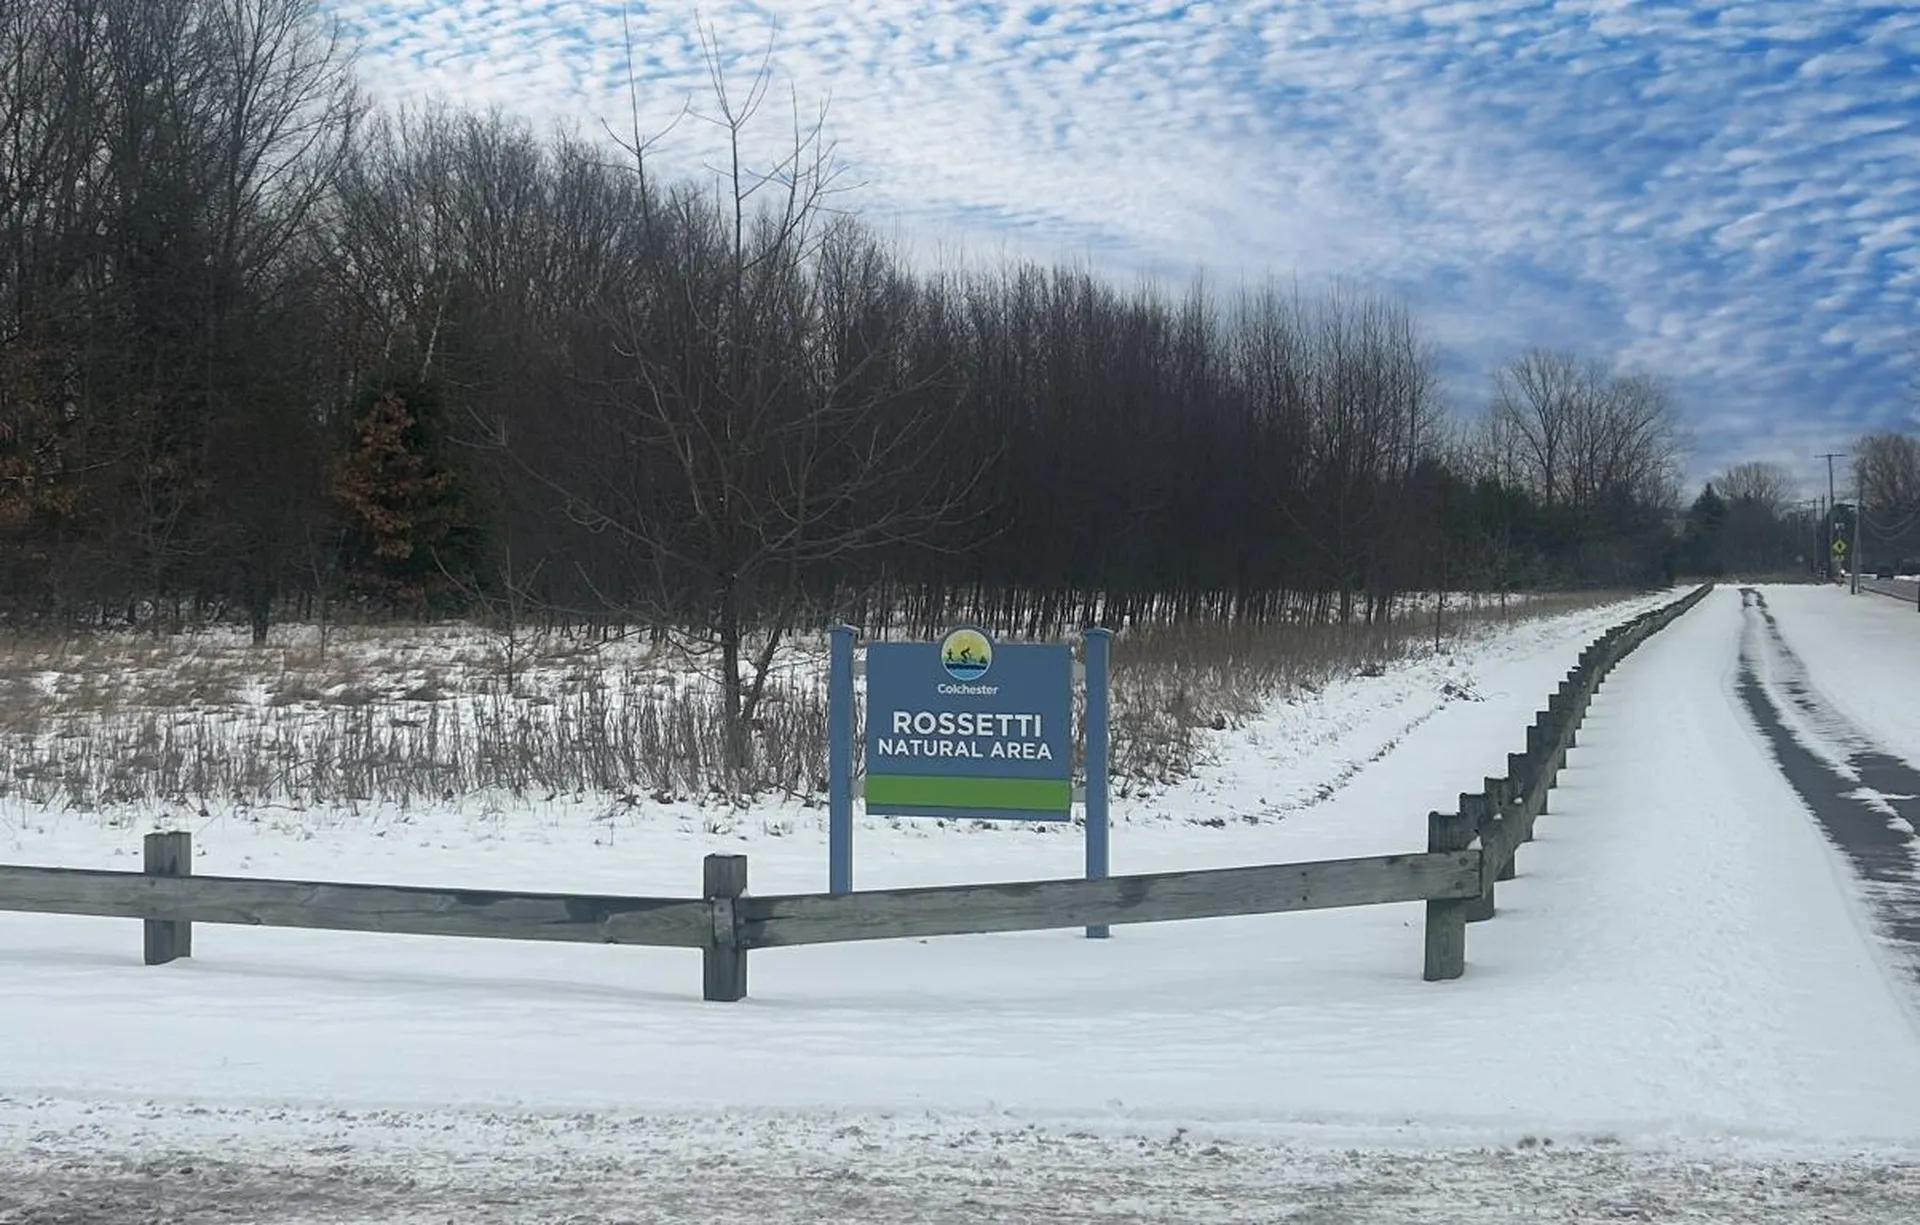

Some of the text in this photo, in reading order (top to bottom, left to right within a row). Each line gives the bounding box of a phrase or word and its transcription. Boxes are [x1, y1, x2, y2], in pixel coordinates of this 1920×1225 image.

[937, 683, 999, 695] Colchester
[893, 711, 1042, 737] ROSSETTI
[878, 739, 1053, 760] NATURAL AREA
